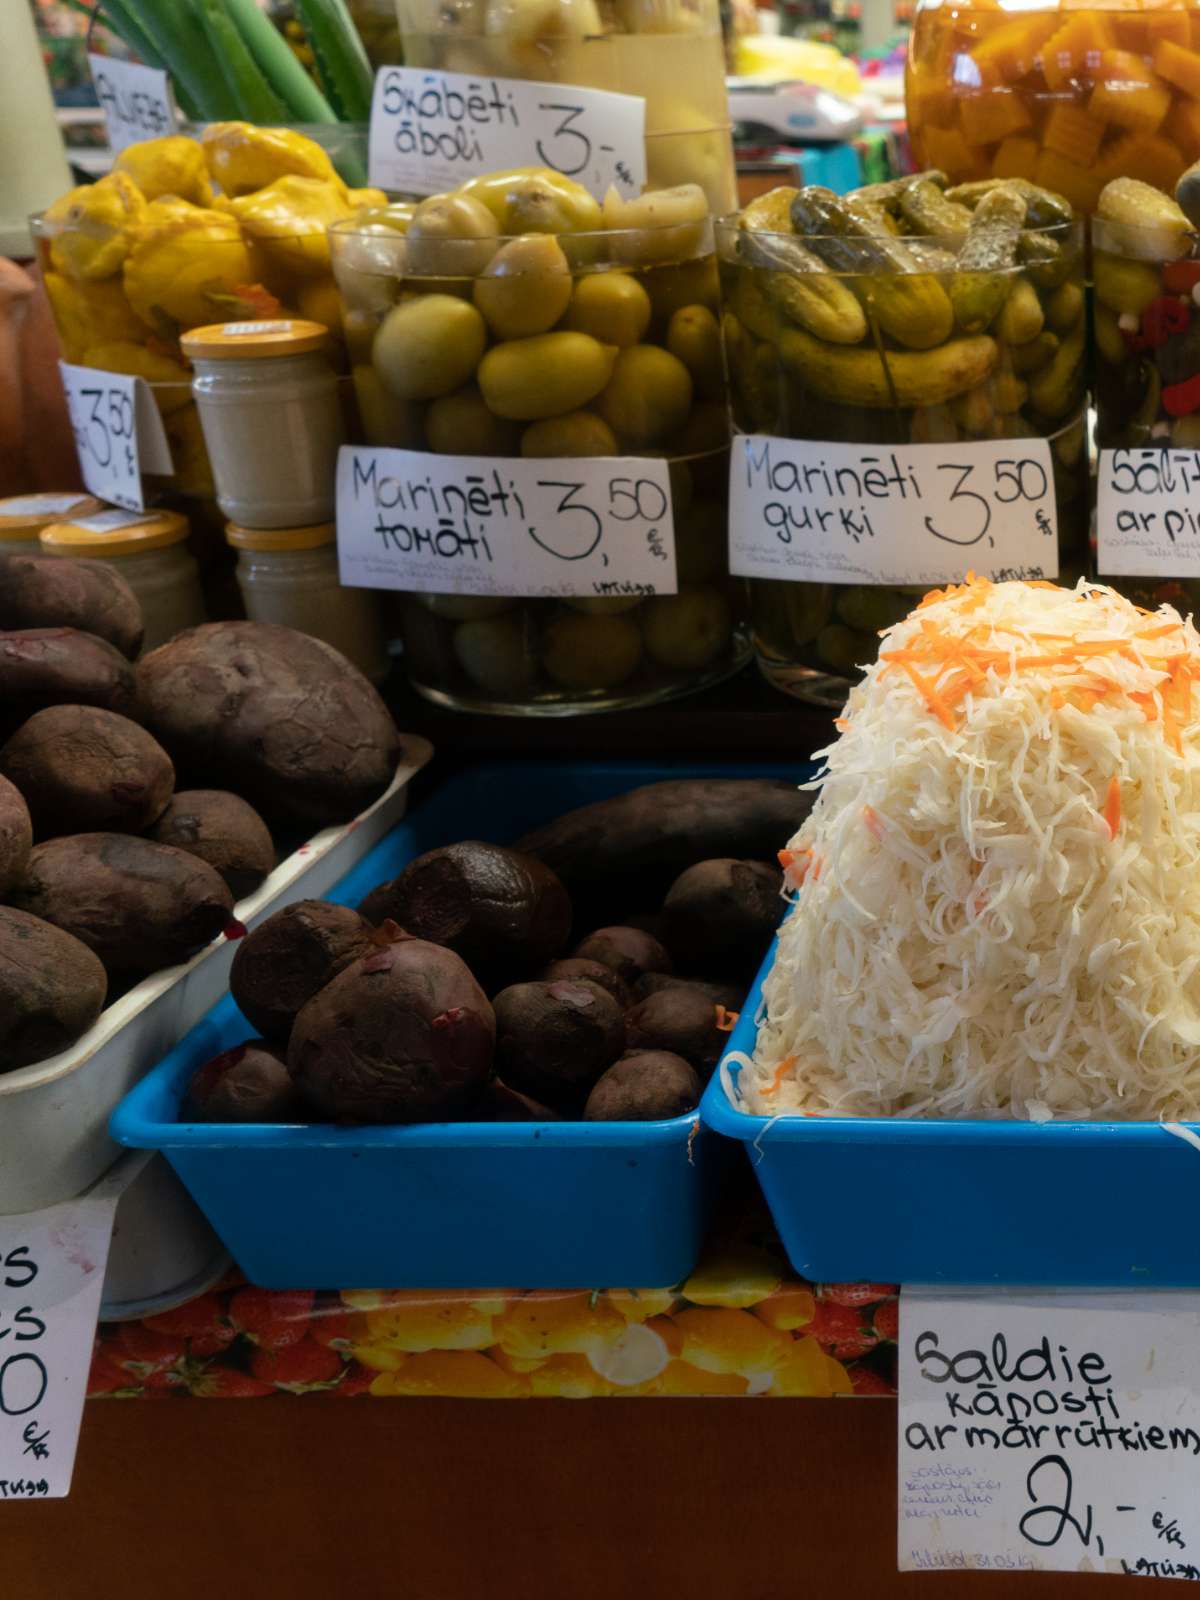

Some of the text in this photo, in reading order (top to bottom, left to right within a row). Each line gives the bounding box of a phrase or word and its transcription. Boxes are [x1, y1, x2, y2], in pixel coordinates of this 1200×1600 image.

[383, 71, 519, 126] Skābēti
[395, 122, 483, 161] āboli
[352, 455, 525, 520] Marinēti
[744, 438, 922, 499] Marinēti
[375, 513, 493, 561] tomāti
[763, 502, 874, 543] gurķi
[1116, 510, 1156, 533] ar
[915, 1330, 1112, 1384] Saldie
[946, 1383, 1119, 1422] kāposti
[905, 1422, 957, 1451] ar
